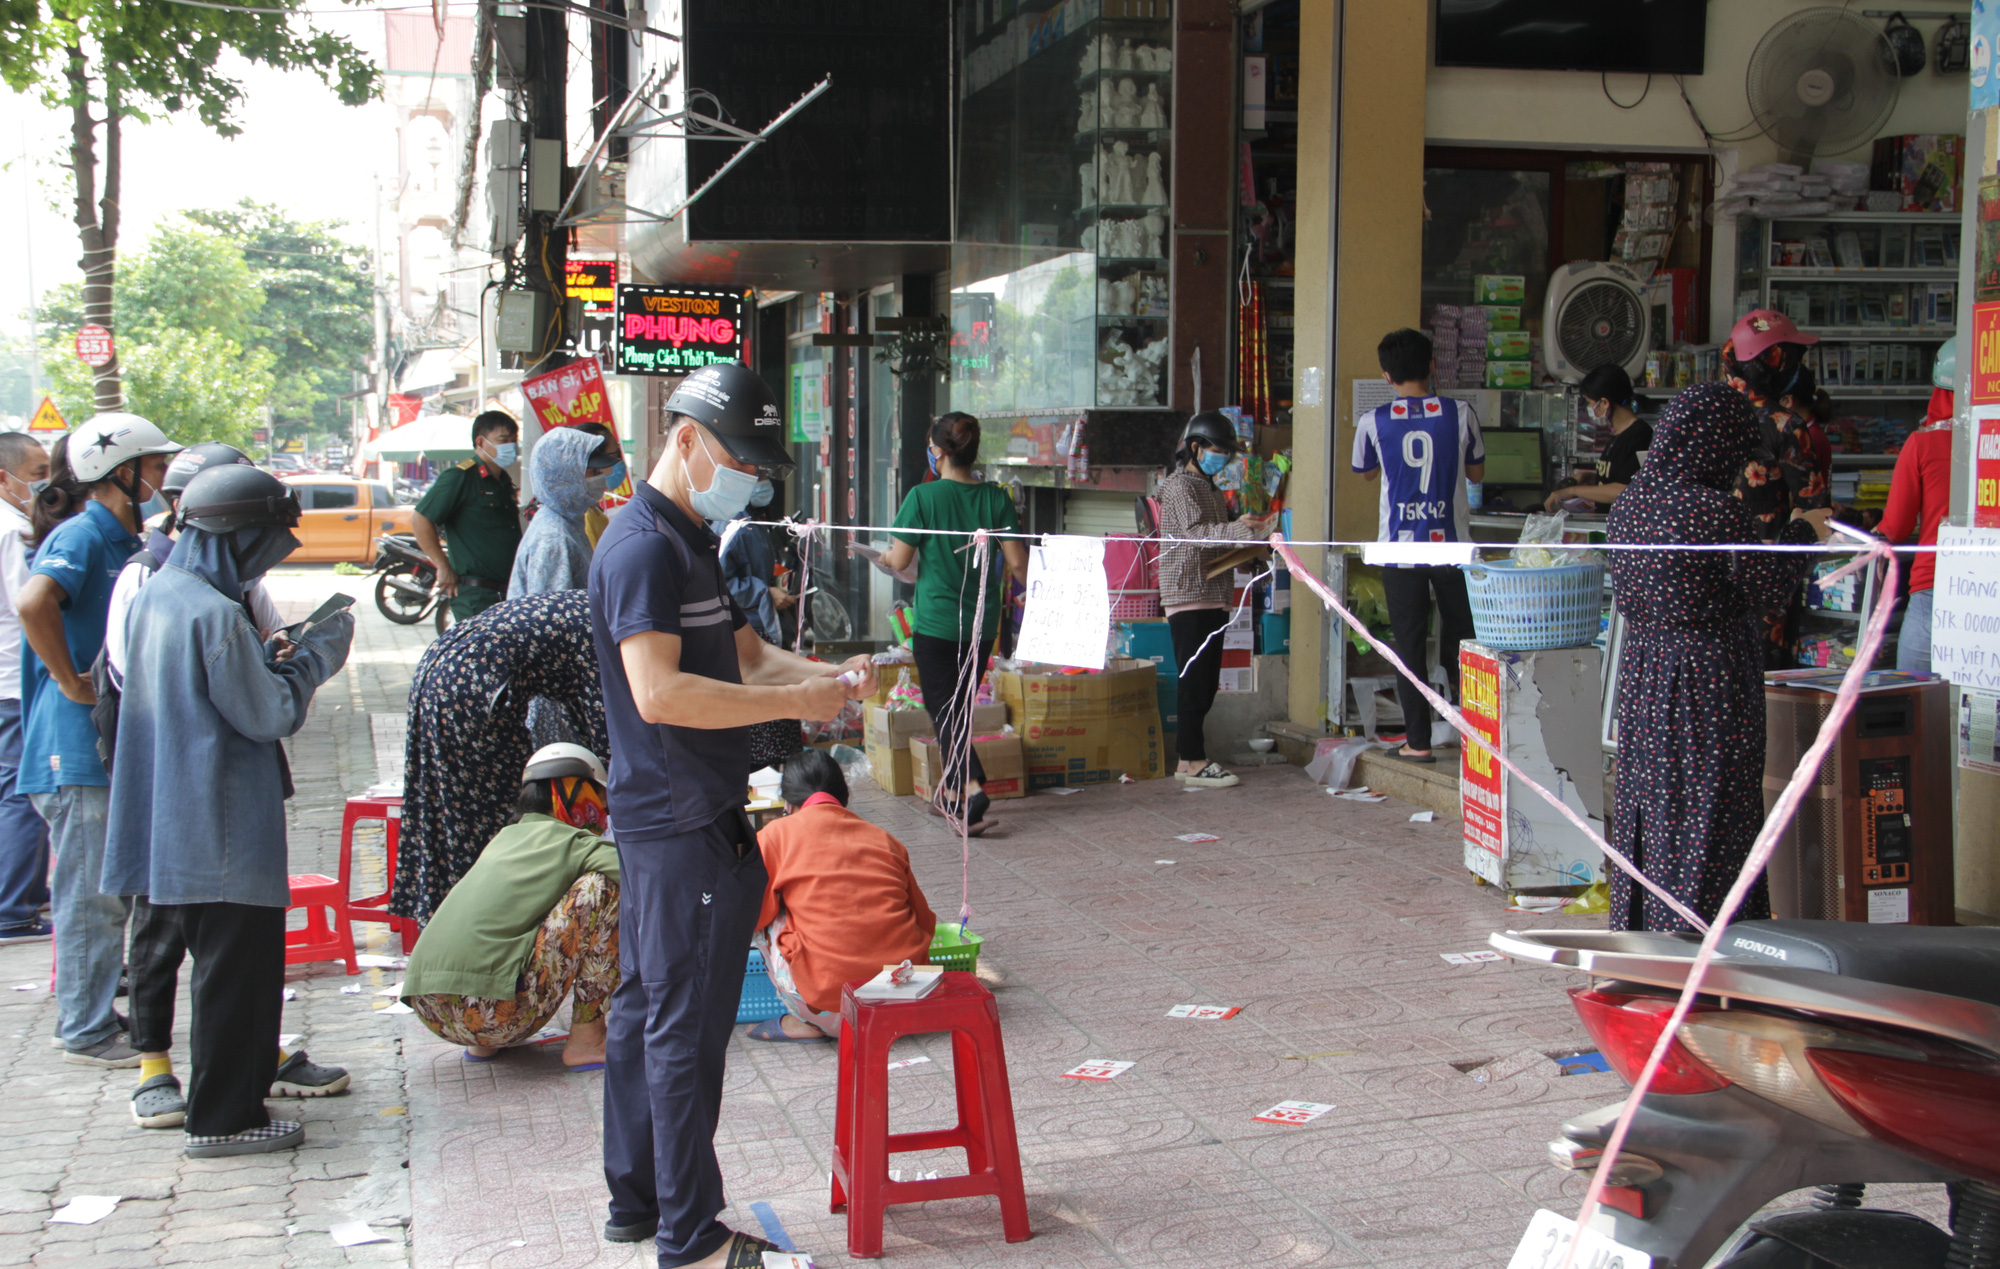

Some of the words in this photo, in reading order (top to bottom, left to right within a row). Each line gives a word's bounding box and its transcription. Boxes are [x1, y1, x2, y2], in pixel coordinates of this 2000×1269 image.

[643, 296, 721, 315] VESTON
[625, 313, 736, 349] PHỤNG
[1979, 313, 2000, 376] CẤ
[78, 340, 111, 354] 251
[624, 345, 655, 368] Phong
[656, 348, 681, 367] Cách
[682, 348, 705, 367] Thời
[527, 374, 559, 400] BÁN
[581, 362, 600, 383] LẺ
[568, 391, 601, 419] CẶP
[1402, 430, 1434, 495] 9
[1978, 478, 1996, 507] ĐEO
[1733, 936, 1788, 961] HONDA
